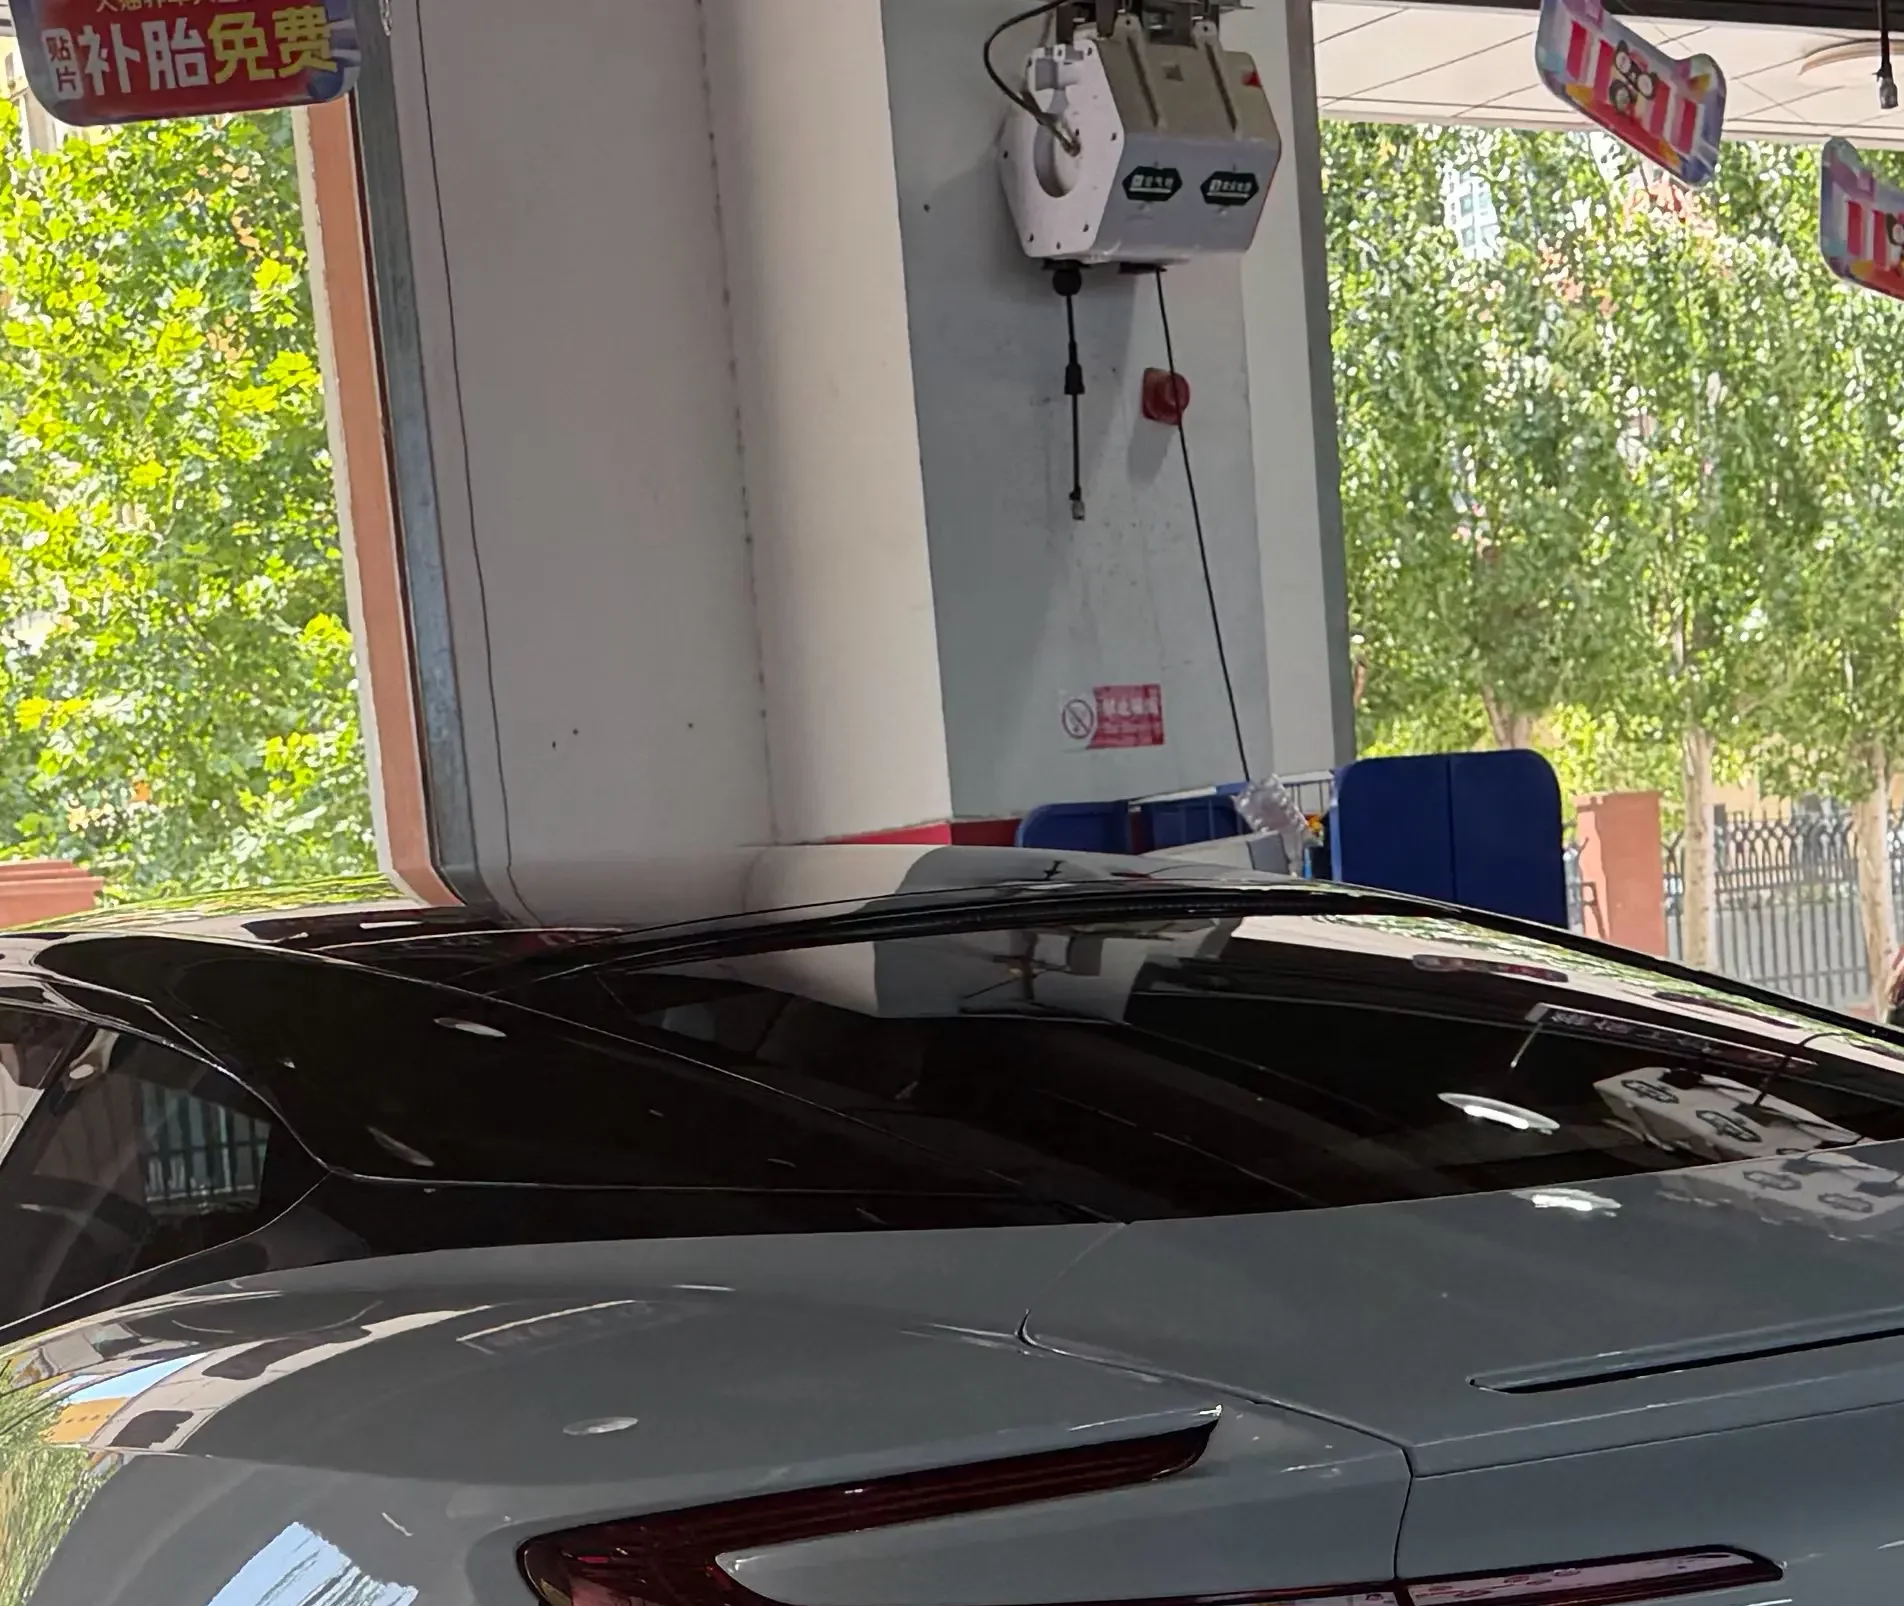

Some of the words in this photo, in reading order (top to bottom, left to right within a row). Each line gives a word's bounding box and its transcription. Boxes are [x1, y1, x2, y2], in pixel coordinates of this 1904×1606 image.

[45, 36, 76, 92] 贴片
[78, 5, 338, 96] 补胎免费
